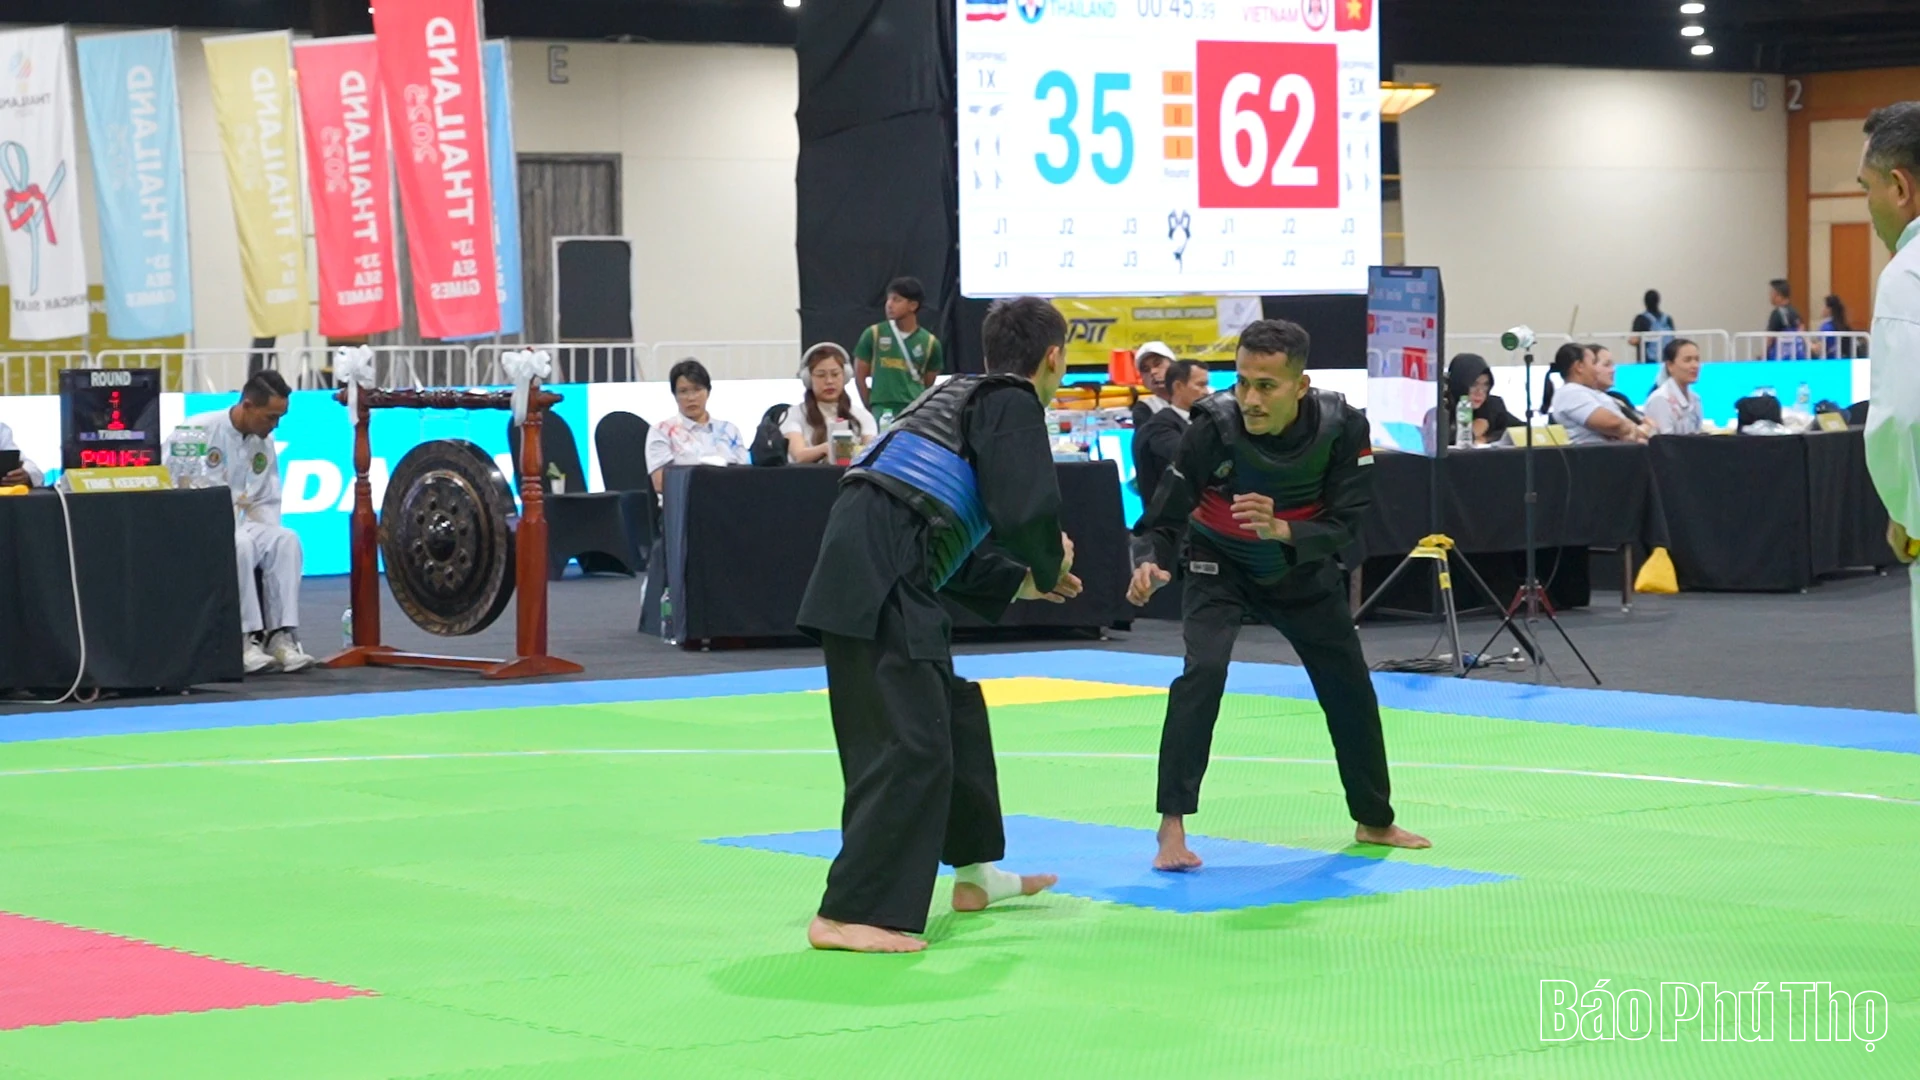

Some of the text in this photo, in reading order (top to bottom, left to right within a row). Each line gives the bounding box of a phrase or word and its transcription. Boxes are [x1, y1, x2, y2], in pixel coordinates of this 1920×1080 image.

[1050, 2, 1117, 18] THAILAND
[1243, 6, 1298, 22] VIETNAM
[547, 45, 568, 84] E
[978, 69, 996, 88] 1X
[1349, 78, 1365, 95] 3X
[1787, 79, 1804, 111] 2
[1035, 70, 1134, 184] 35
[1219, 72, 1319, 188] 62
[993, 218, 1007, 235] J1
[1059, 218, 1073, 235] J2
[1123, 218, 1137, 235] J3
[1221, 217, 1235, 234] J1
[1281, 217, 1295, 234] J2
[1340, 217, 1354, 234] J3
[994, 251, 1008, 268] J1
[1060, 251, 1074, 268] J2
[1123, 251, 1137, 268] J3
[1222, 250, 1236, 267] J1
[1282, 250, 1296, 267] J2
[1341, 250, 1355, 267] J3
[1066, 318, 1118, 343] PTT
[91, 371, 131, 387] ROUND
[82, 475, 160, 491] TIME KEEPER
